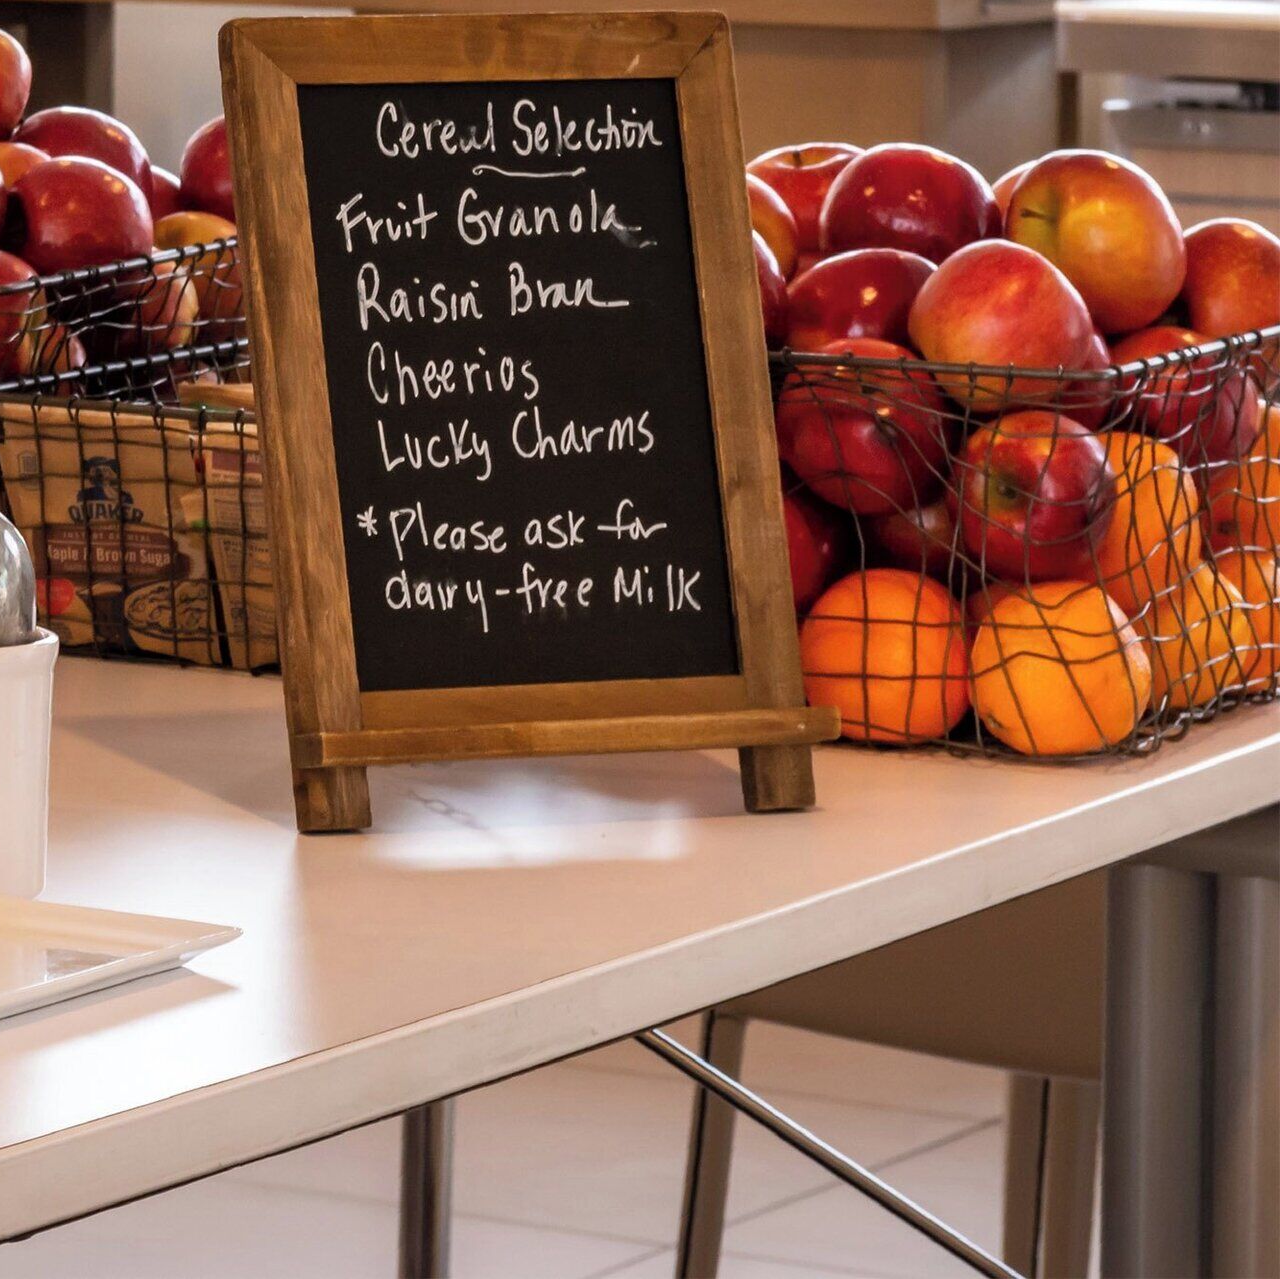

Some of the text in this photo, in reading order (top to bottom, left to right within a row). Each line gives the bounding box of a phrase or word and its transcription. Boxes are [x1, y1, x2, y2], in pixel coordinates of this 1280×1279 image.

[376, 99, 663, 159] Cereal Selection
[335, 187, 641, 253] Fruit Granola
[357, 261, 630, 331] Raisin Bran
[367, 341, 539, 406] Cheerios
[377, 405, 654, 482] Lucky Charms
[524, 510, 587, 549] ask
[597, 498, 668, 540] for
[139, 548, 172, 568] Suga
[385, 562, 594, 633] dairy-free
